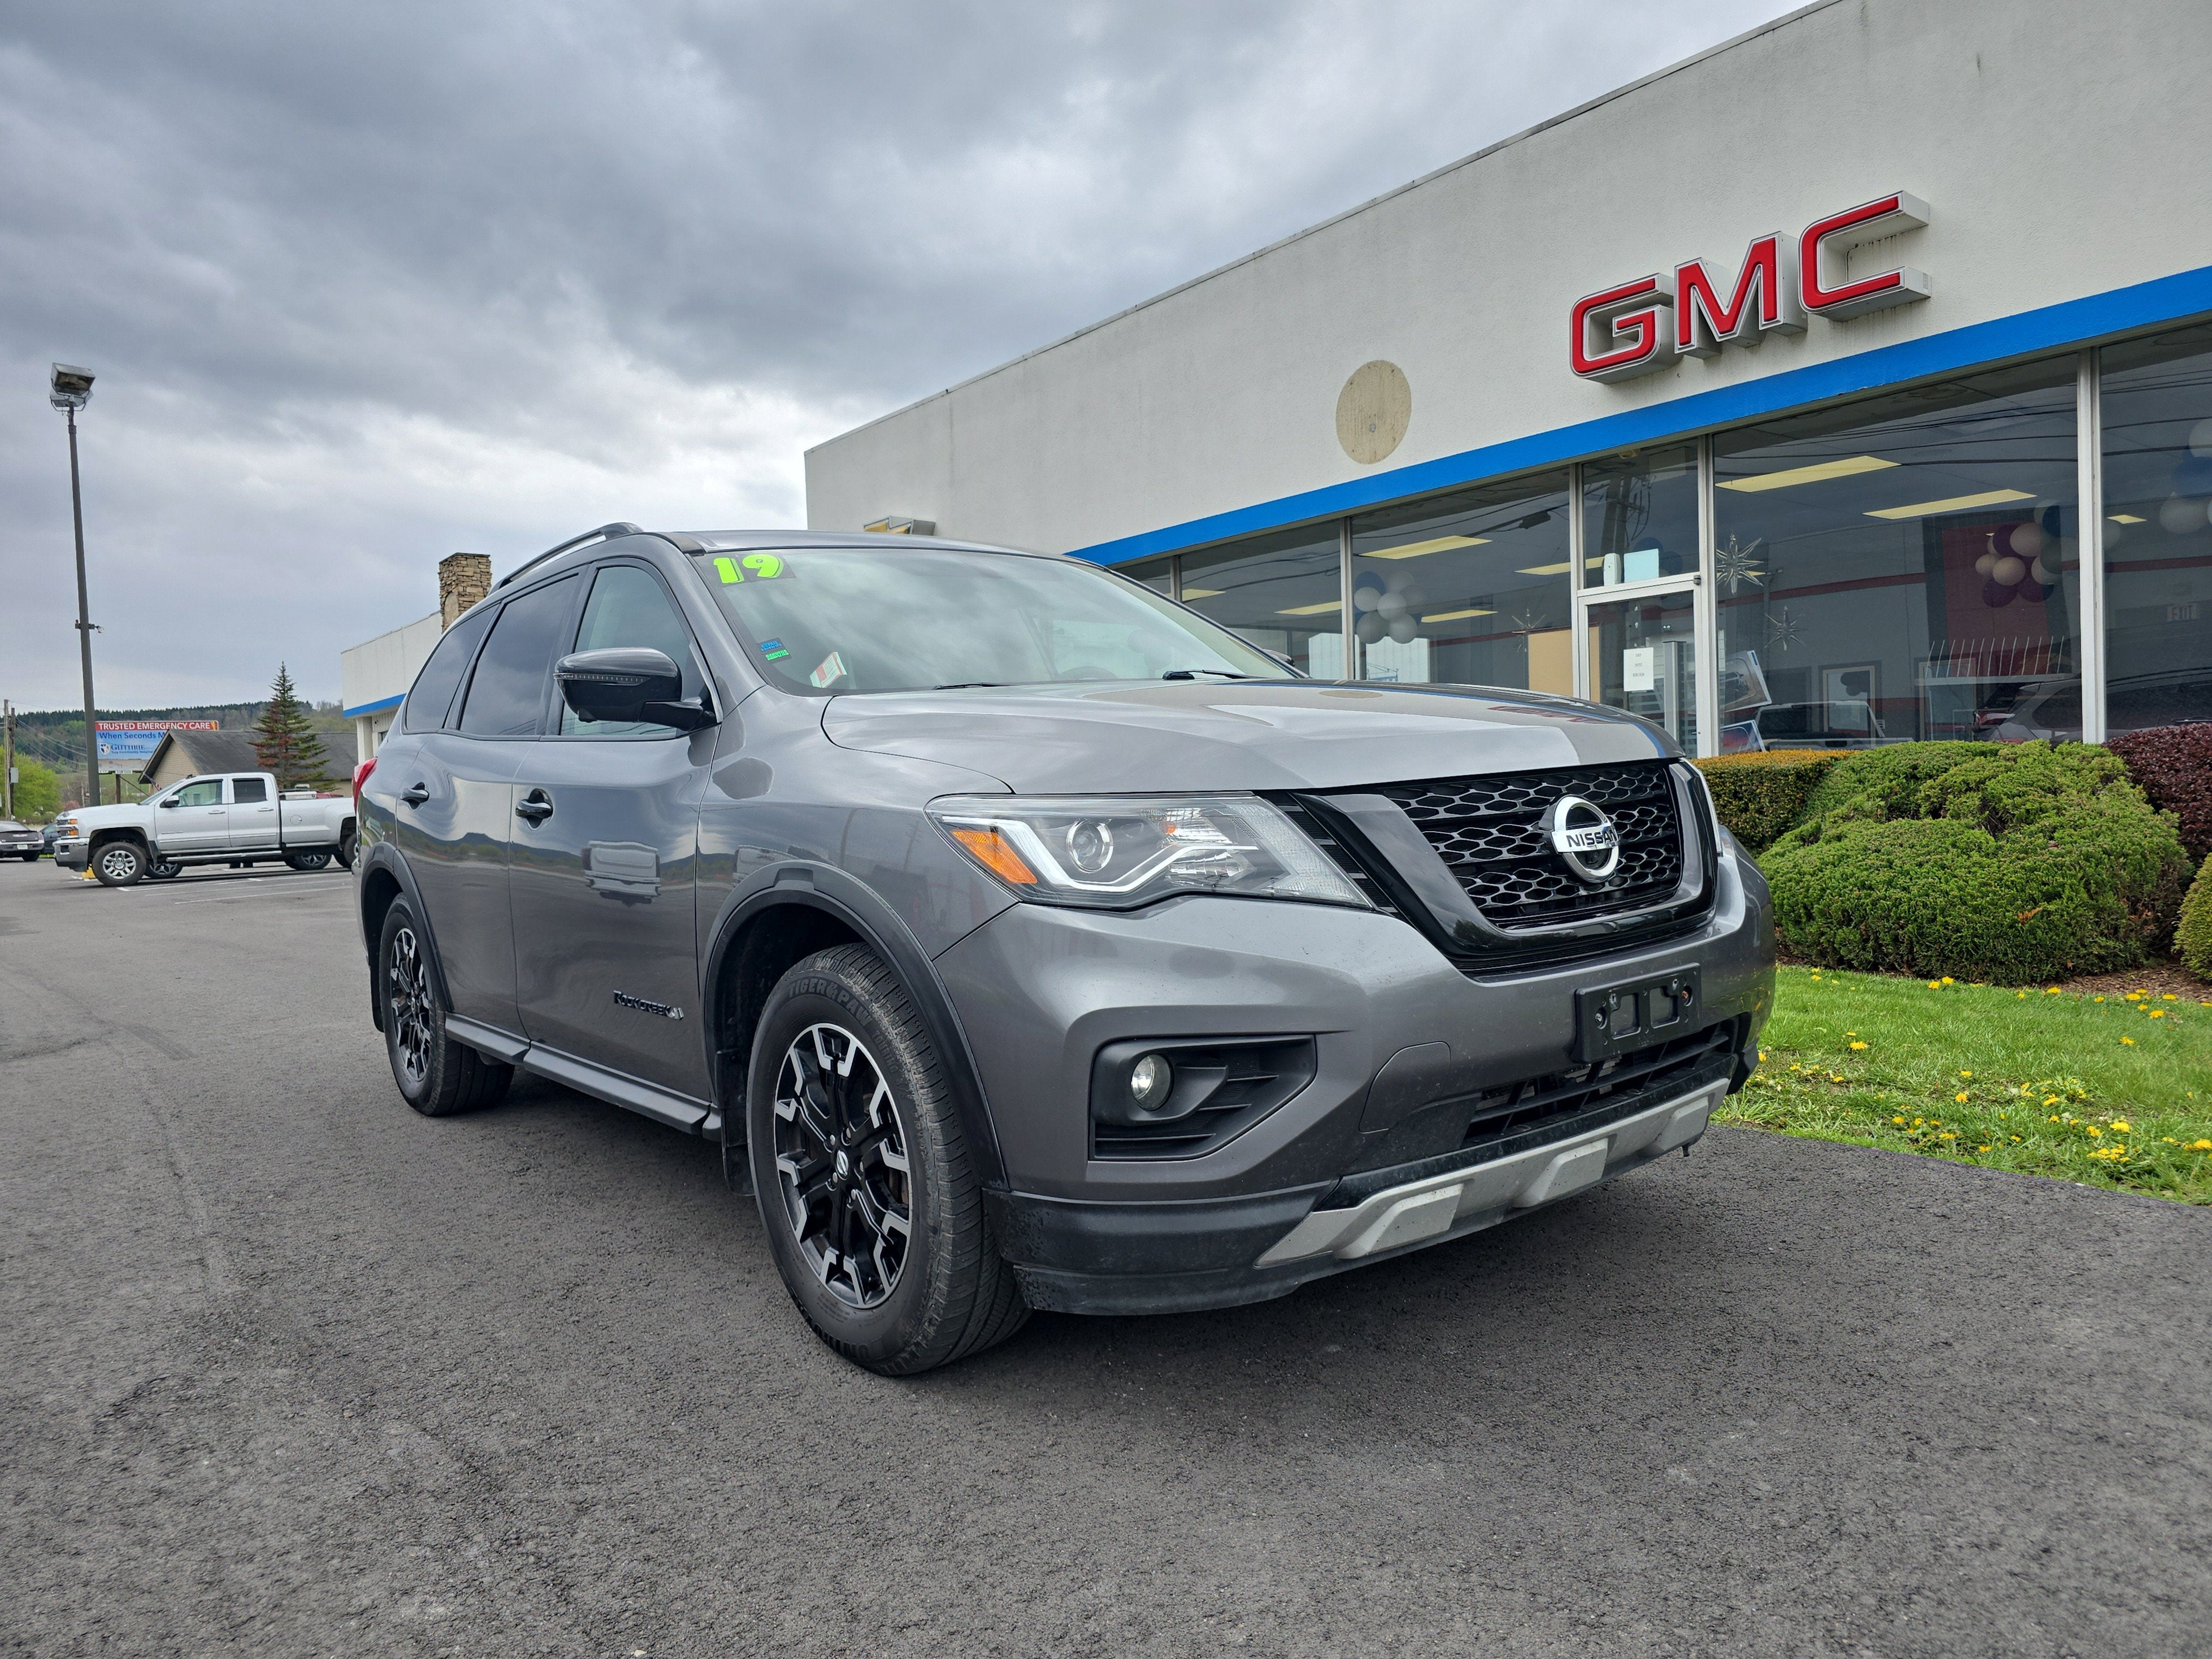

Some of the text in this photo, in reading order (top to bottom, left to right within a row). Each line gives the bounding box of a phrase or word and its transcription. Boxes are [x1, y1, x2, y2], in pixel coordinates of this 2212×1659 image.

[1570, 191, 1919, 381] GMC
[713, 554, 784, 583] 19
[2171, 605, 2193, 620] EXIT
[1566, 830, 1618, 847] NISSAN
[788, 978, 872, 1026] TIGER PAW
